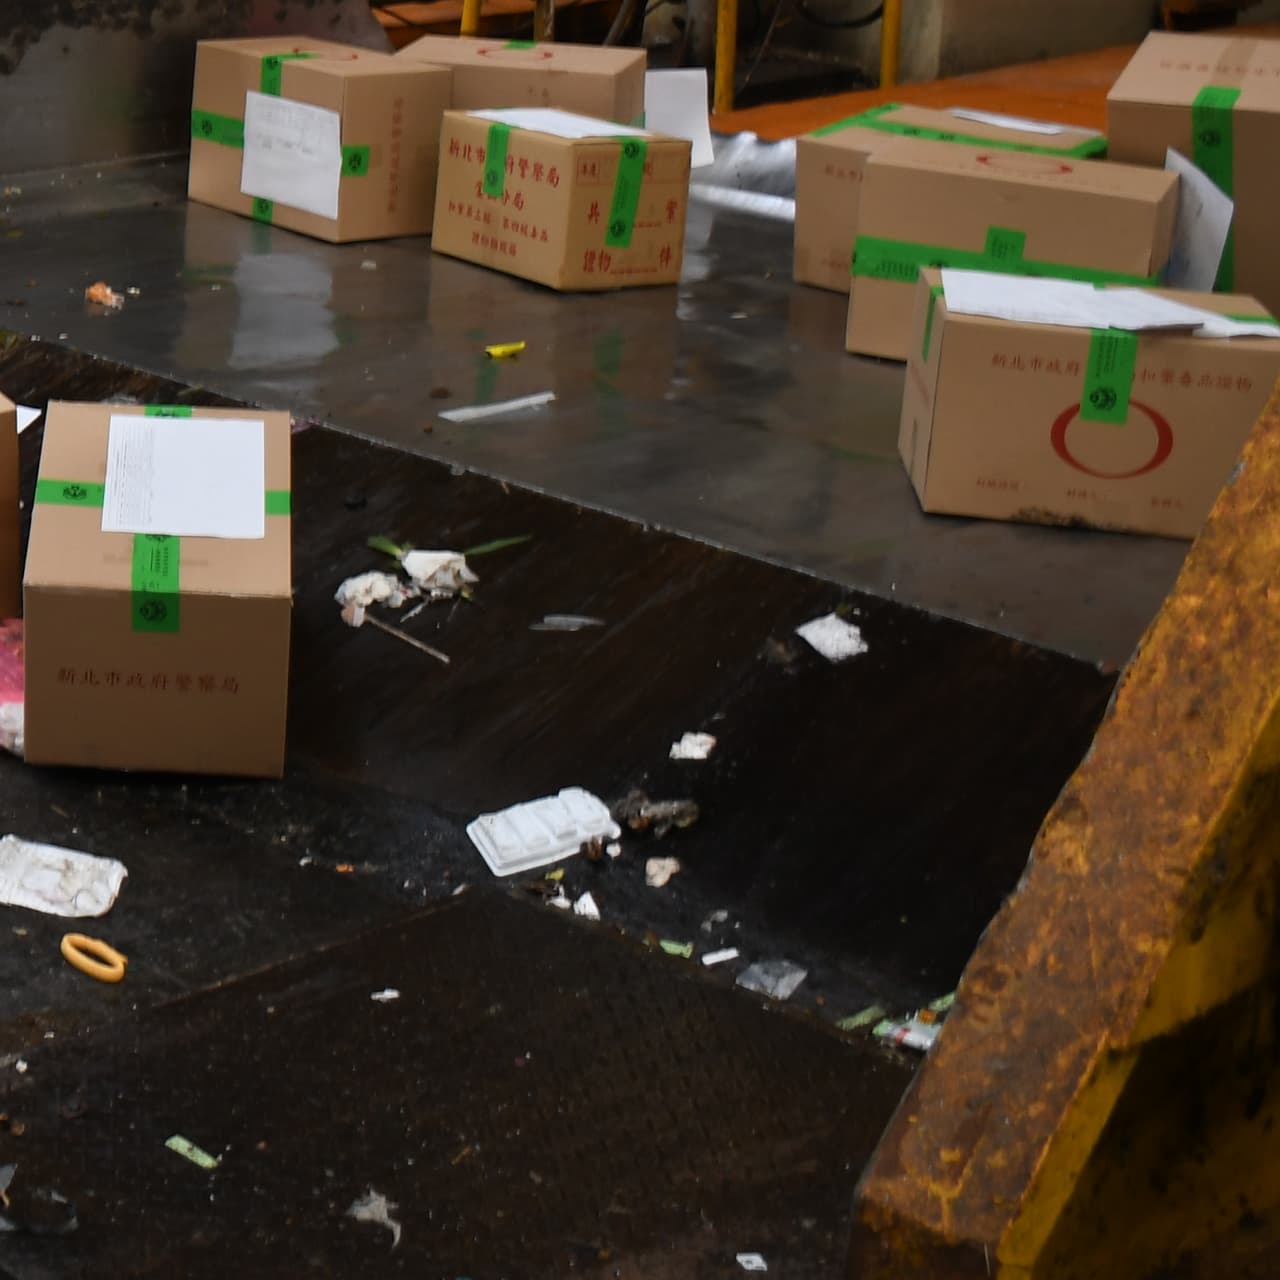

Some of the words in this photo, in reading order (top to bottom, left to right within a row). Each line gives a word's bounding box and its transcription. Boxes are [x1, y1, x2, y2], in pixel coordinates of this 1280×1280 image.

[449, 137, 560, 188] 新北市府警察局
[58, 667, 239, 695] 新北市政府警察局
